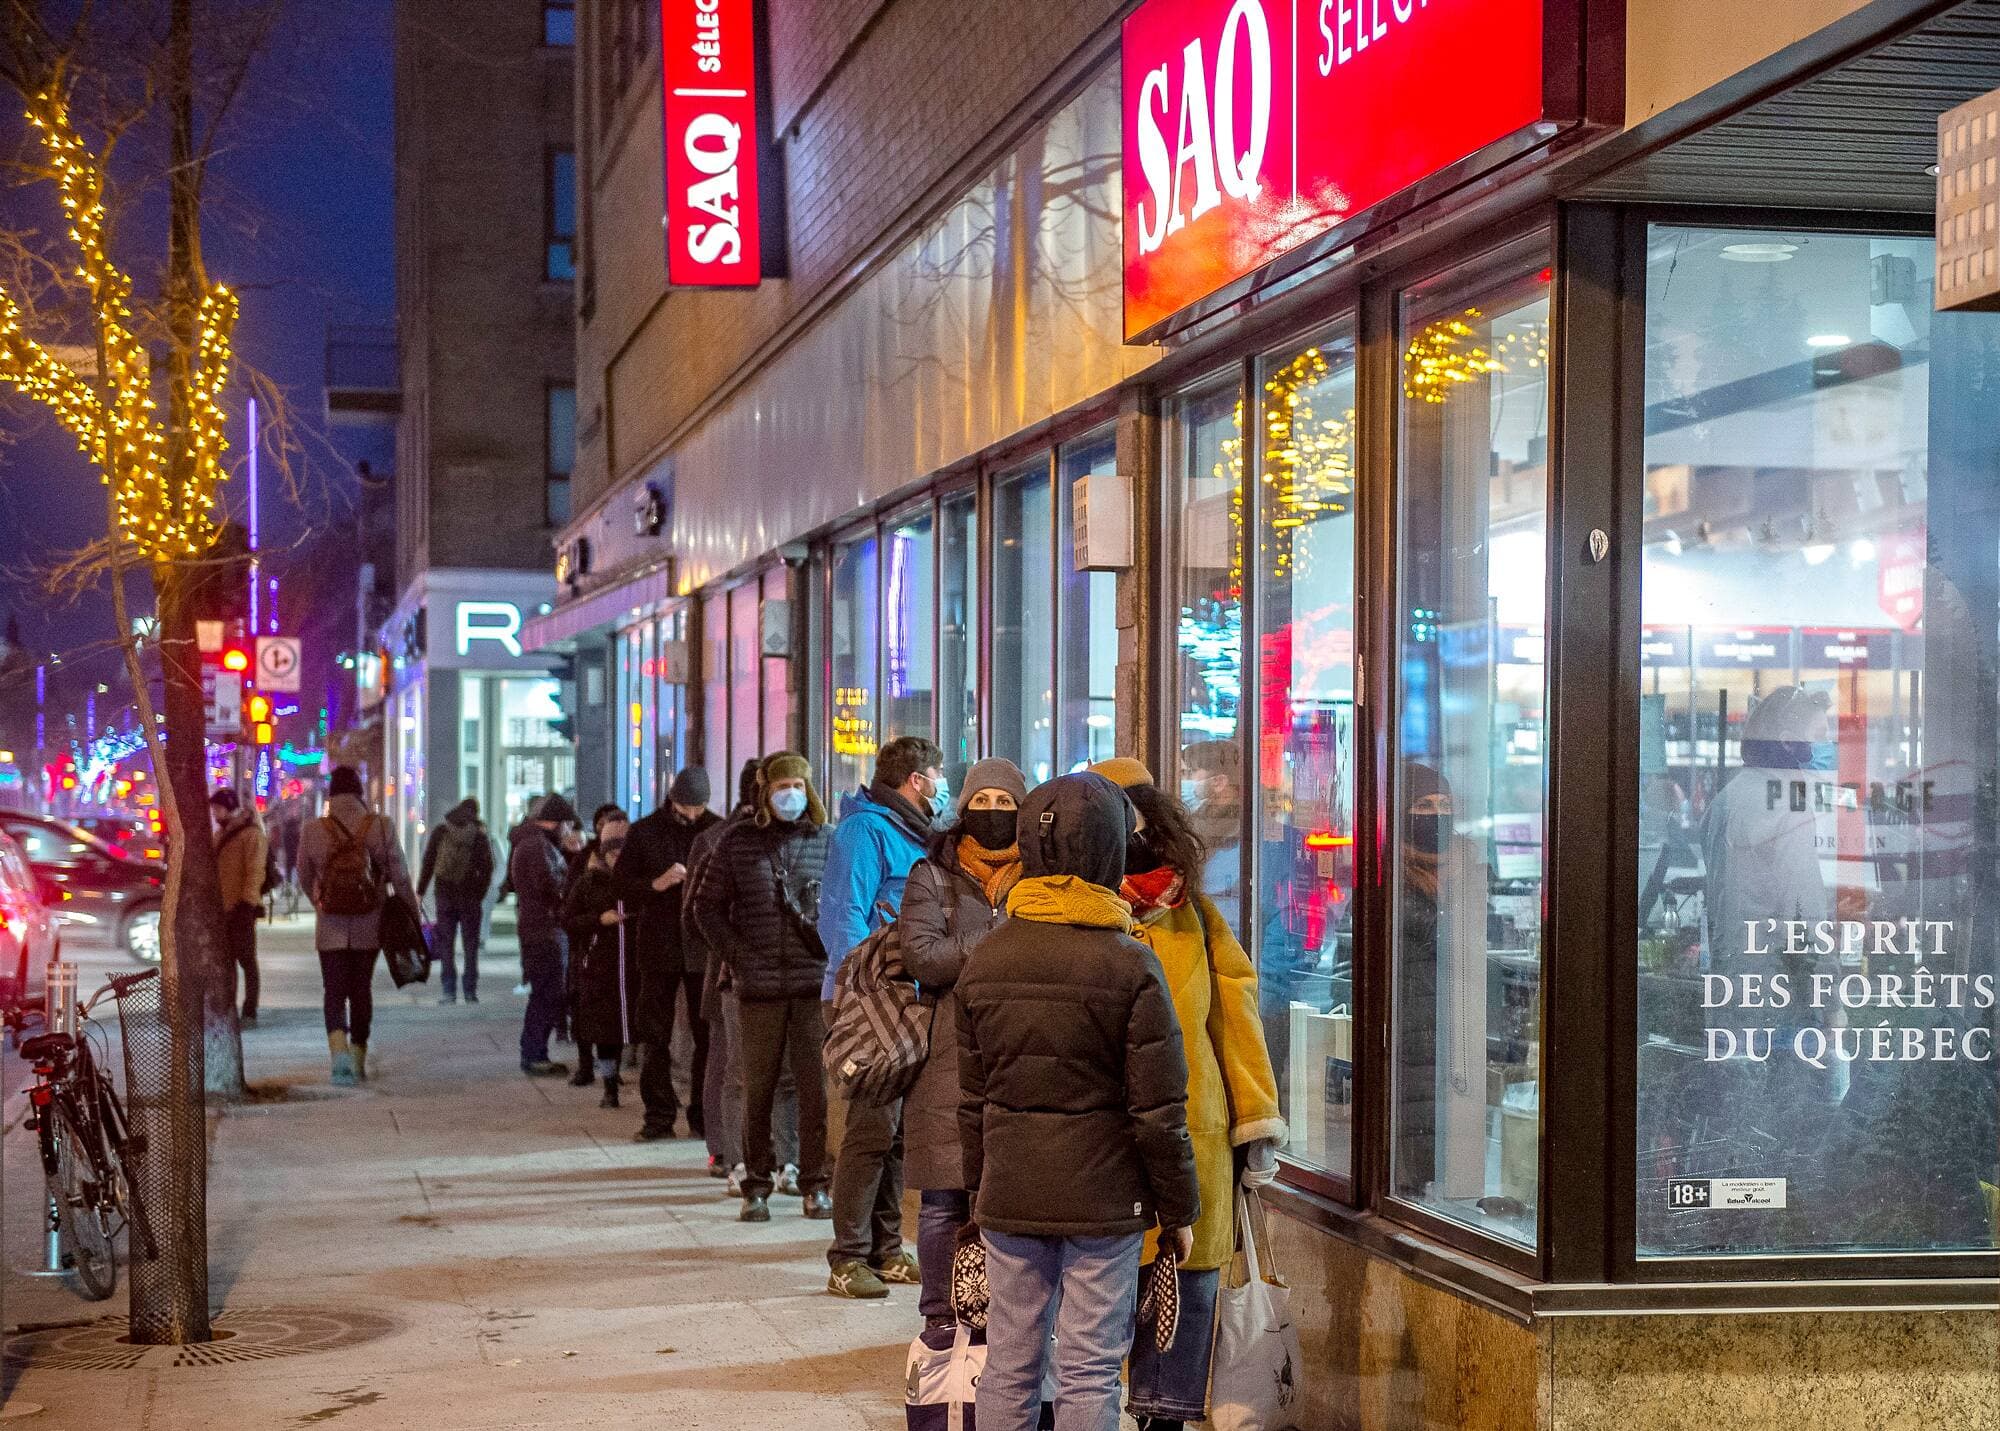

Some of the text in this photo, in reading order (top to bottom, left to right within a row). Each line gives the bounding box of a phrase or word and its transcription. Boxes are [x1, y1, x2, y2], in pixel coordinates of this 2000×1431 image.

[1137, 0, 1273, 256] SAQ
[684, 113, 742, 265] SAQ
[456, 601, 522, 657] R
[1743, 918, 1953, 955] L'ESPRIT
[1700, 966, 1995, 1008] DES FORÊTS
[1704, 1020, 1992, 1068] DU QUÉBEC
[1673, 1184, 1708, 1204] 18+
